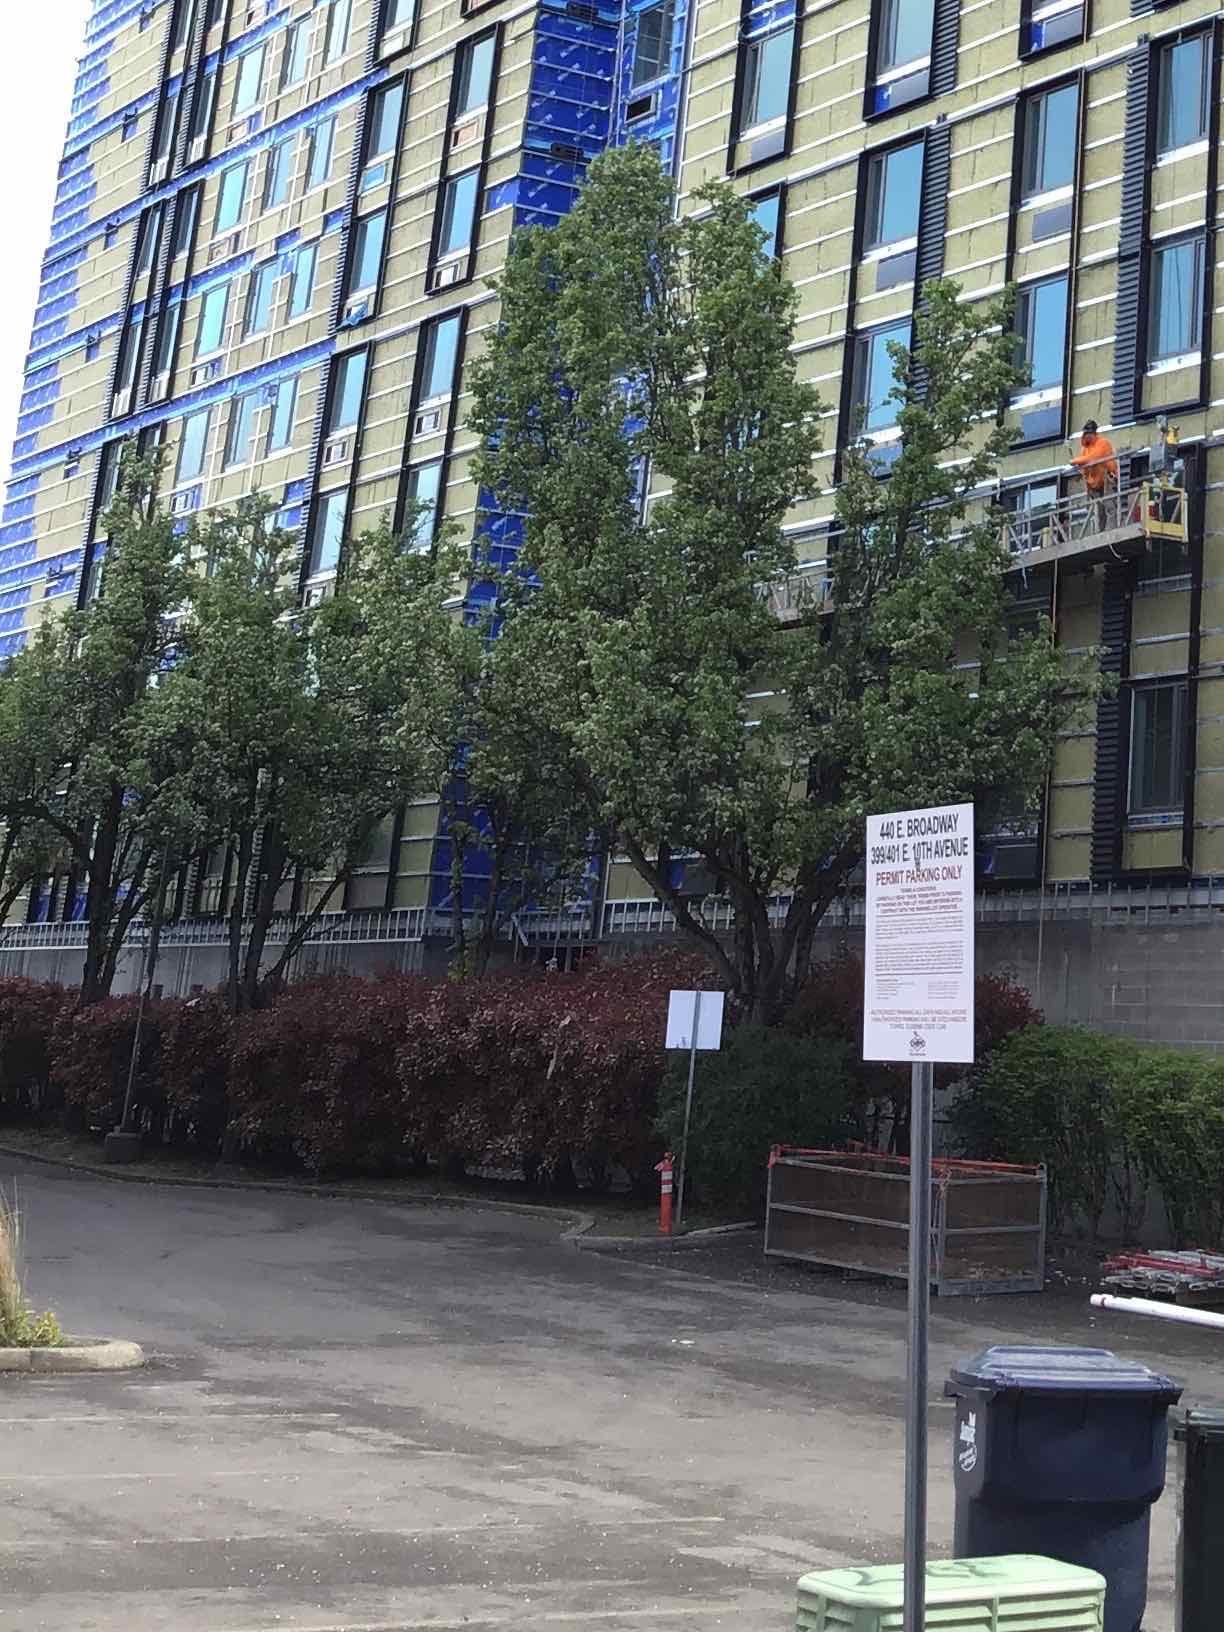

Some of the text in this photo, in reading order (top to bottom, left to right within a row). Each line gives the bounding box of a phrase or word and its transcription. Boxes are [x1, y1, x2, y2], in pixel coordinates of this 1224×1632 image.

[880, 821, 895, 840] 440
[907, 813, 959, 838] BROADWAY
[934, 837, 969, 859] AVENUE
[876, 864, 963, 886] PERMIT PARKING ONLY
